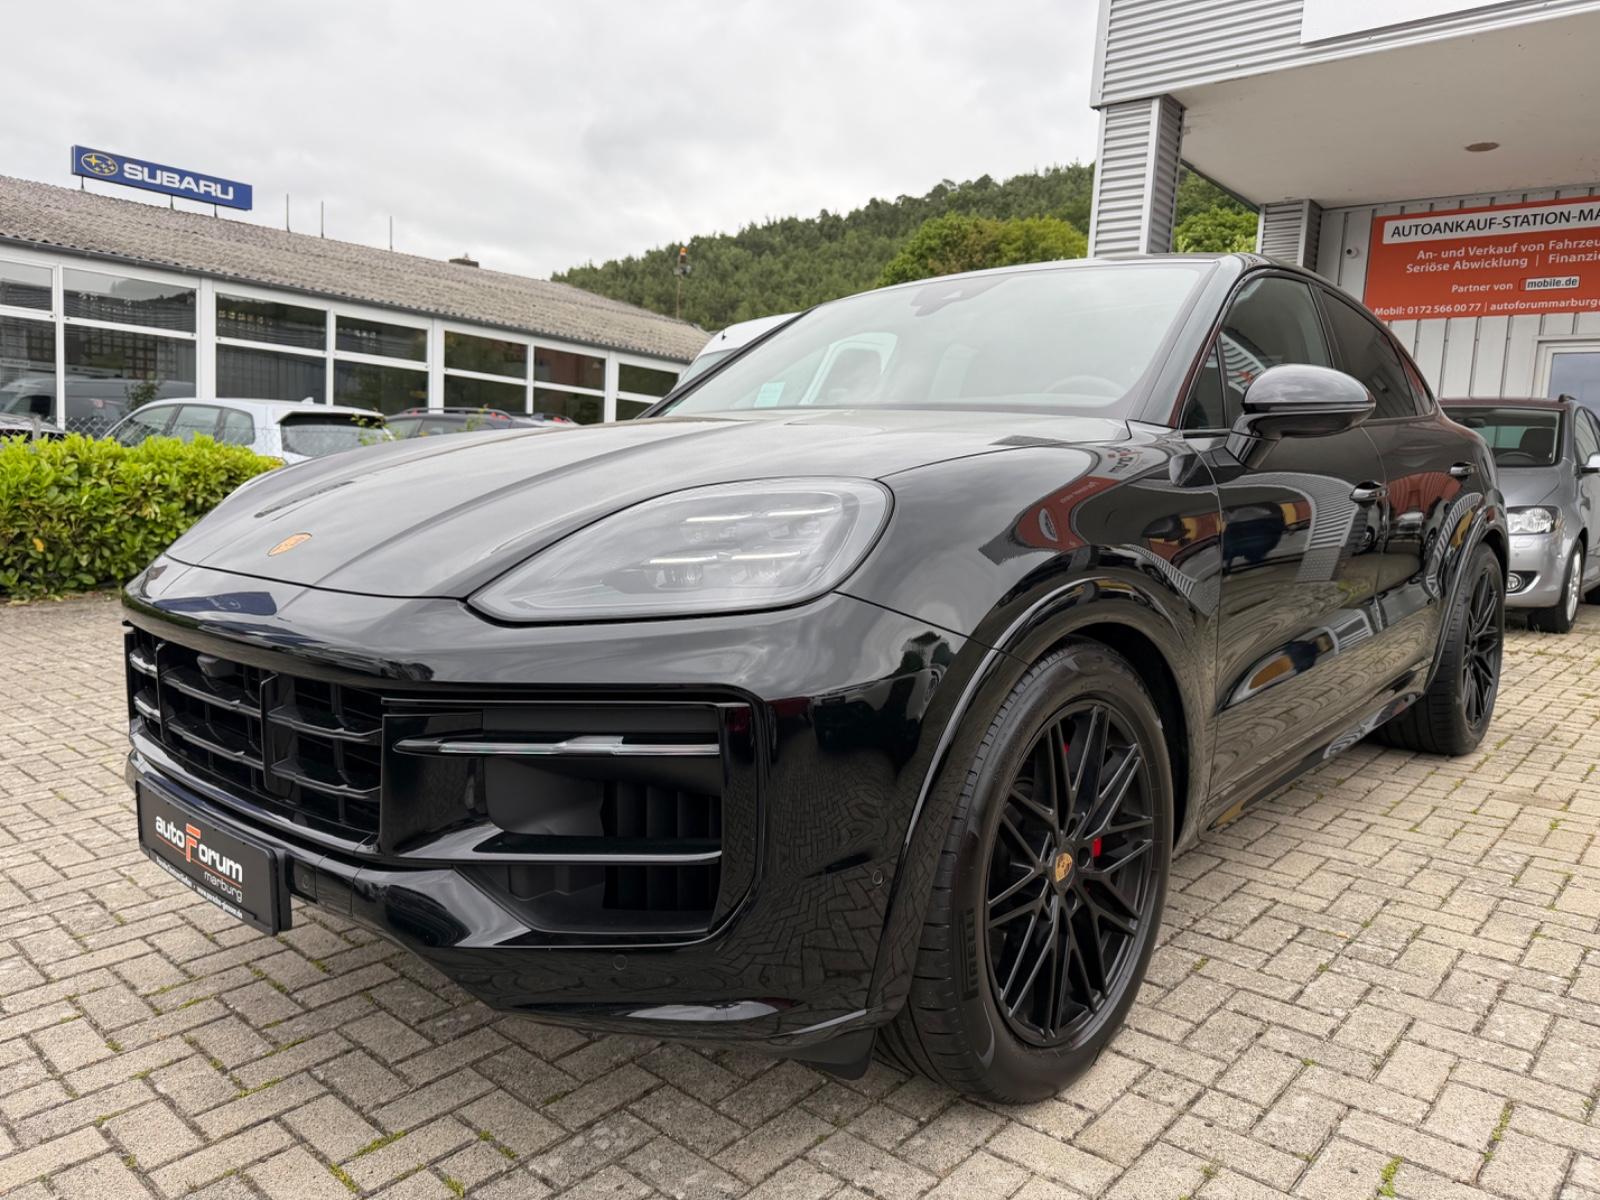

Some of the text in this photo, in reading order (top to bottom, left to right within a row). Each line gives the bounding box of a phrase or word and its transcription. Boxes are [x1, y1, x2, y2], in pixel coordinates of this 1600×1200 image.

[123, 162, 234, 200] SUBARU
[1417, 250, 1438, 260] An-
[1441, 247, 1465, 258] und
[1468, 243, 1518, 256] Verkauf
[1521, 243, 1545, 252] von
[1406, 251, 1600, 273] Seriöse Abwicklung Finanzi
[1452, 277, 1578, 293] Partner von mobile.de
[1375, 297, 1600, 316] Mobil: 0172 566 00 77 autoforummarburg
[204, 871, 242, 903] marburg
